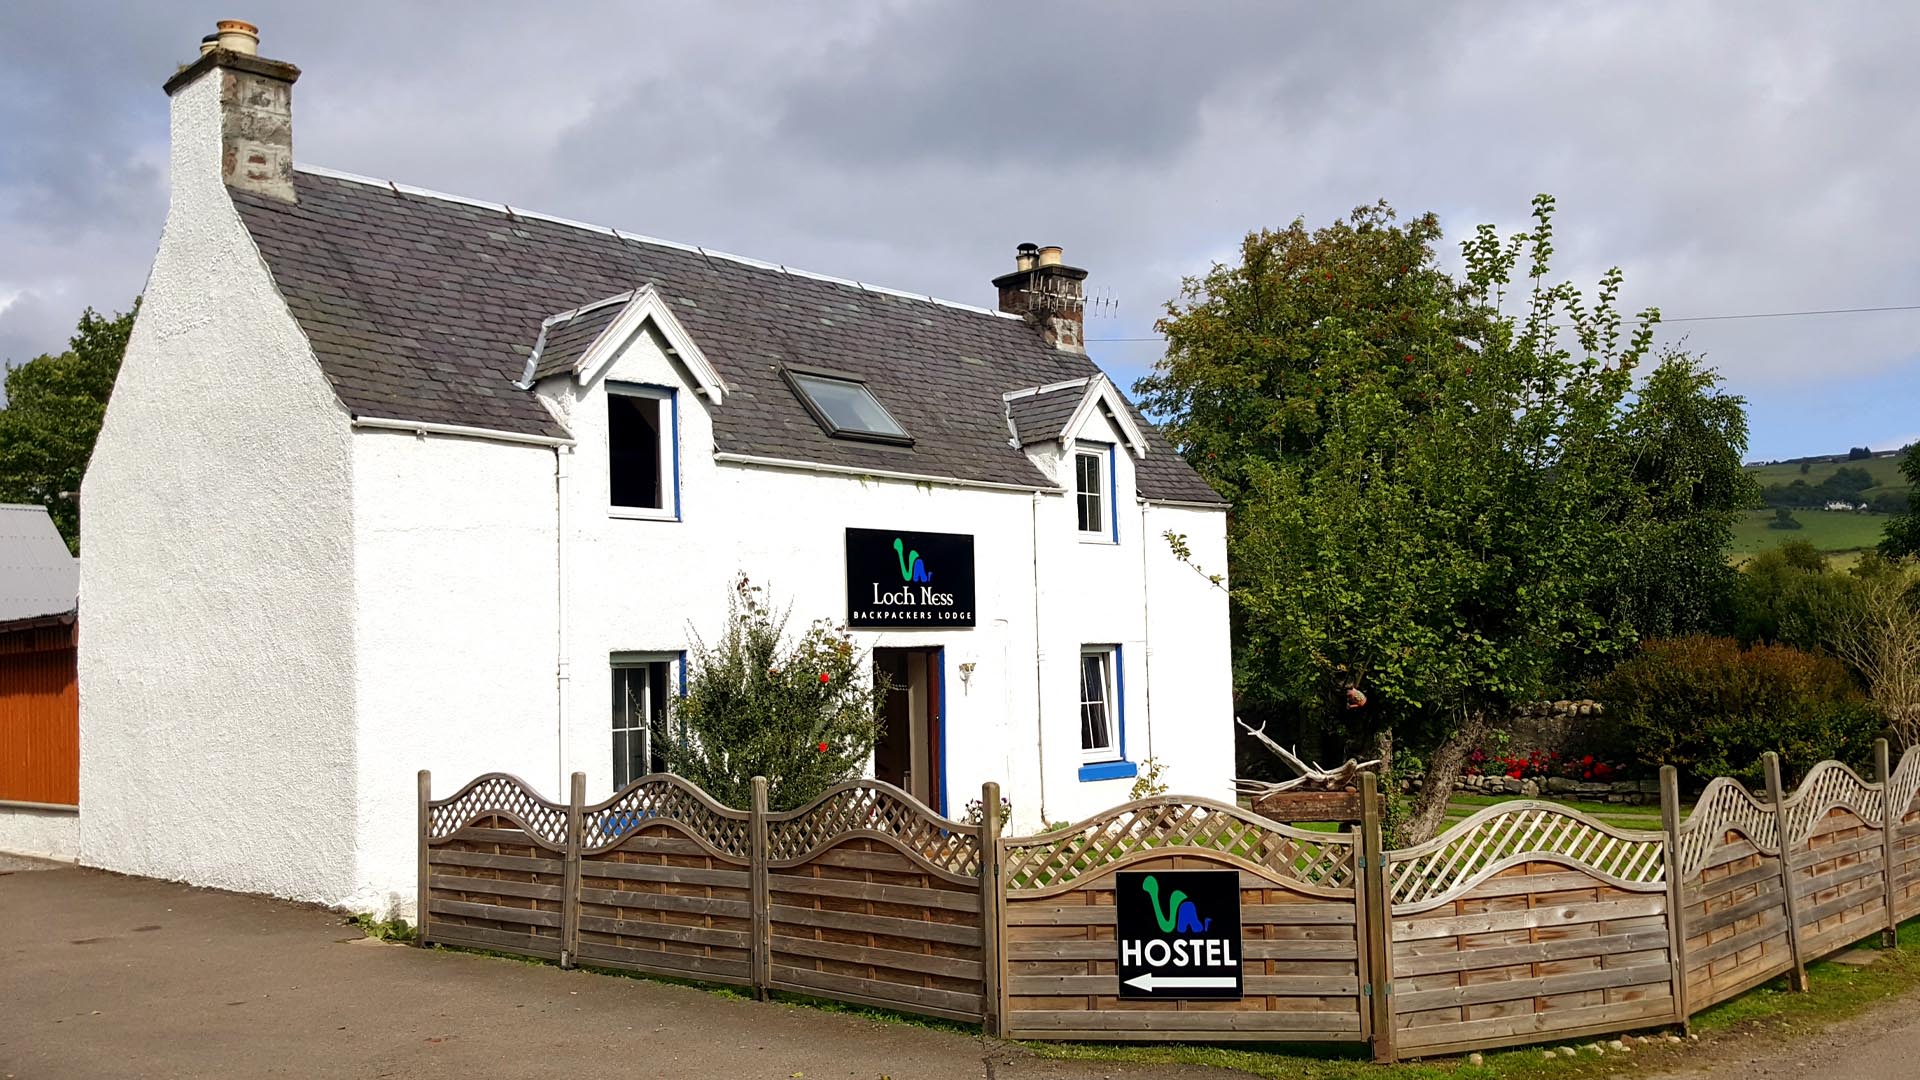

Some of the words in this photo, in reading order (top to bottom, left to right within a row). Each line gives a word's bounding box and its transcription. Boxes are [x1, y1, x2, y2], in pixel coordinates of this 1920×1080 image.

[873, 582, 916, 606] Loch
[920, 586, 954, 606] Ness
[853, 611, 932, 620] BACKPACKERS
[938, 611, 972, 620] LODGE
[1122, 939, 1237, 967] HOSTEL
